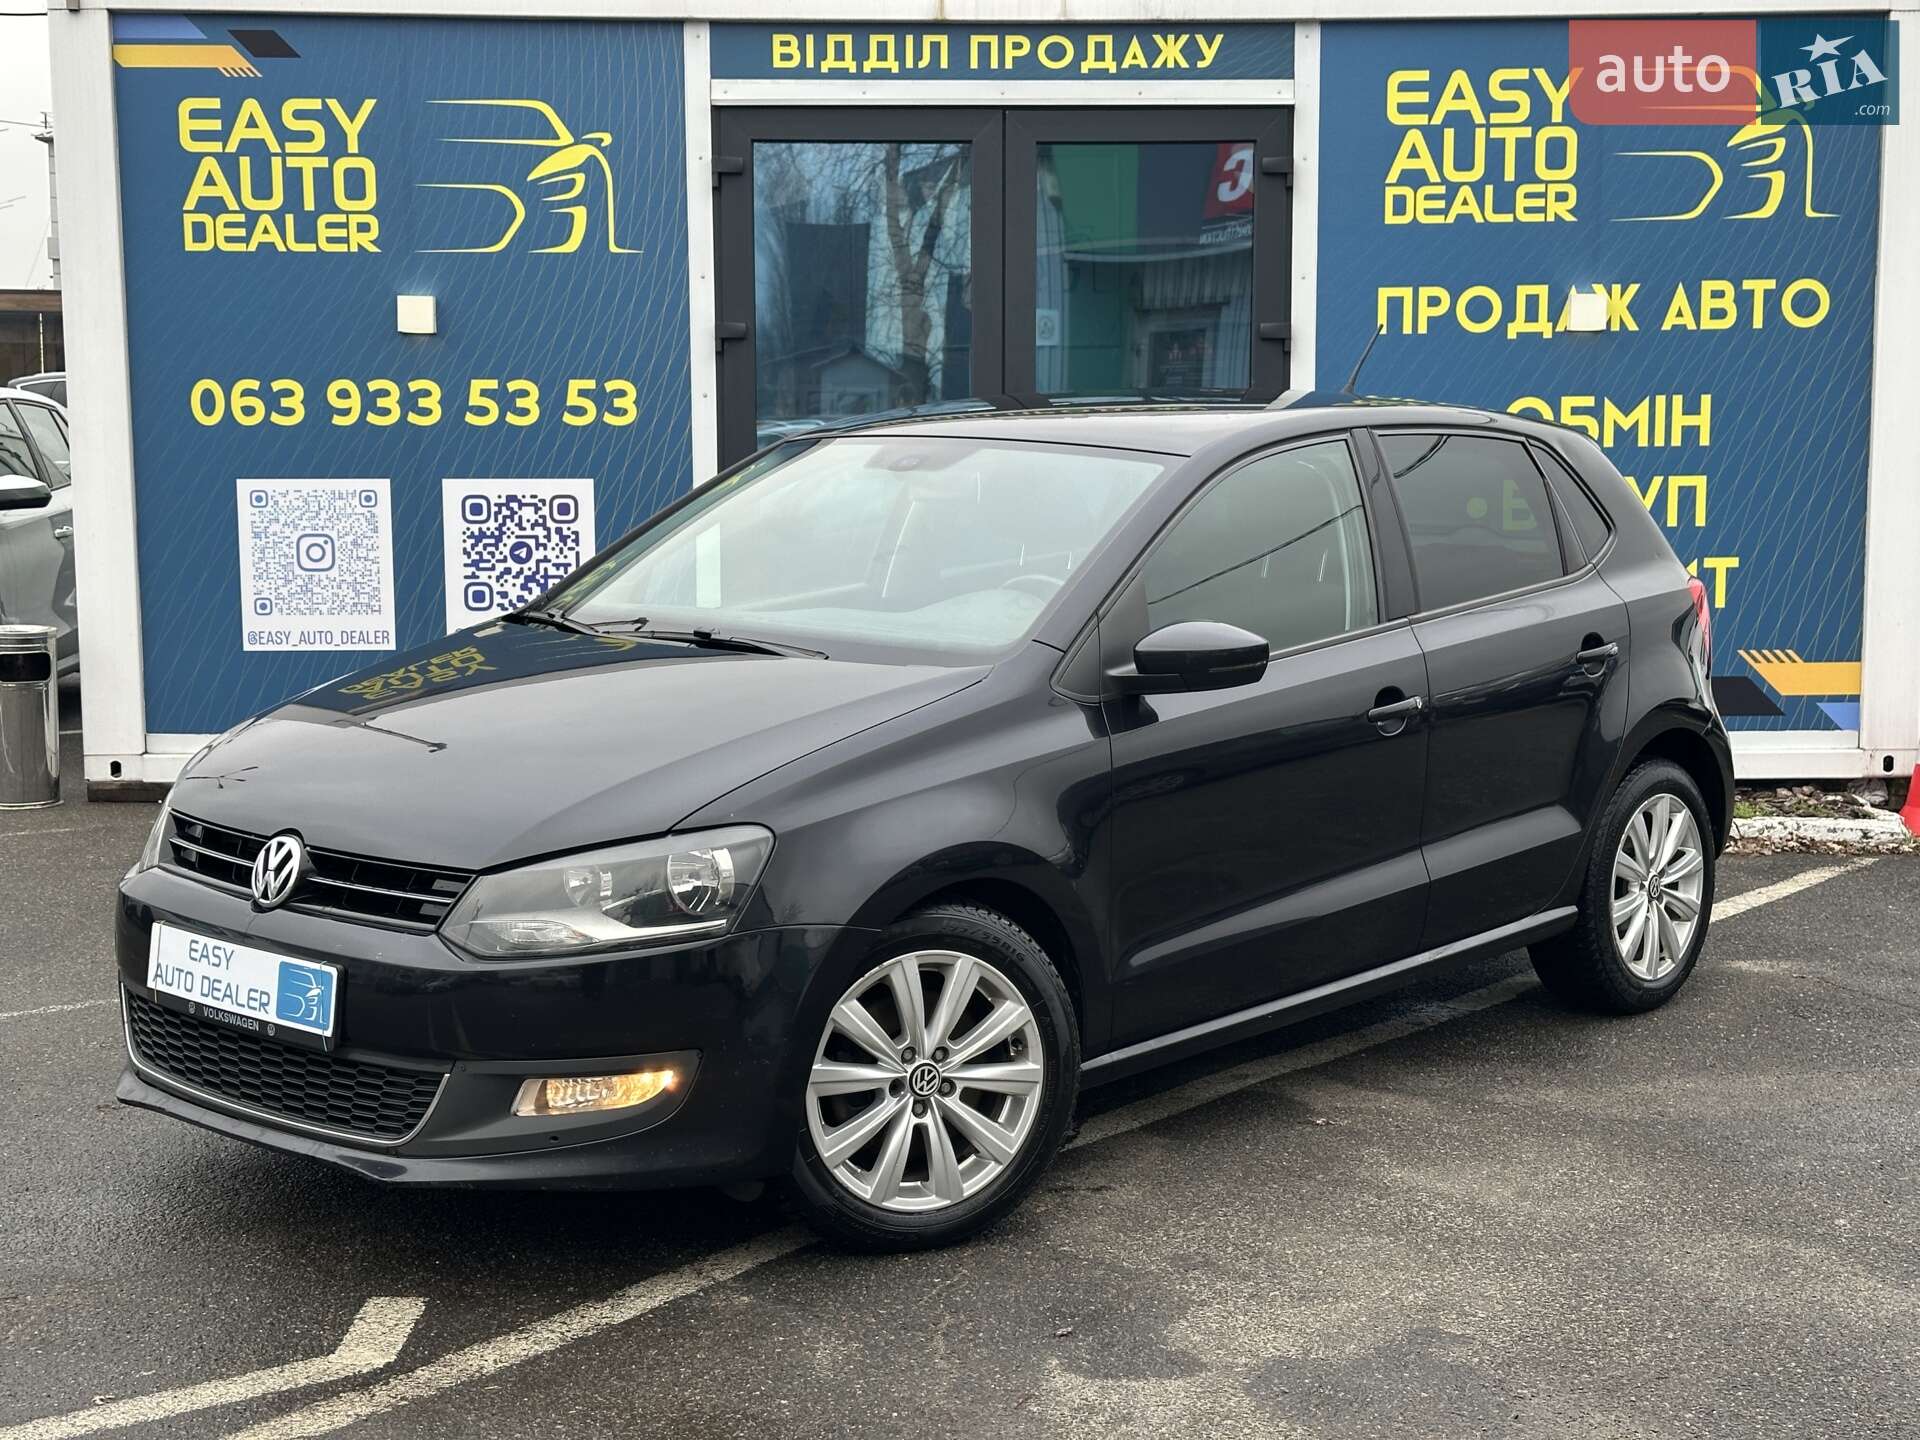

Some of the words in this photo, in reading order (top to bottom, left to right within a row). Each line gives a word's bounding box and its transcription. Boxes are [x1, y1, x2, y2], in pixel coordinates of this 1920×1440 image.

[771, 34, 950, 72] ВІДДІЛ
[969, 33, 1224, 73] ПРОДАЖУ
[1386, 66, 1584, 124] EASY
[178, 97, 377, 153] EASY
[1386, 125, 1579, 183] AUTO
[184, 156, 378, 212] AUTO
[1384, 182, 1577, 225] DEALER
[183, 212, 381, 253] DEALER
[1662, 278, 1831, 331] АВТО
[190, 379, 305, 426] 063
[325, 379, 442, 426] 933
[464, 379, 541, 426] 53
[562, 379, 639, 426] 53
[247, 630, 390, 647] @EASY_AUTO_DEALER
[187, 939, 236, 969] EASY
[153, 962, 195, 993] AUTO
[200, 974, 271, 1015] DEALER
[202, 1006, 260, 1032] VOLKSWAGEN
